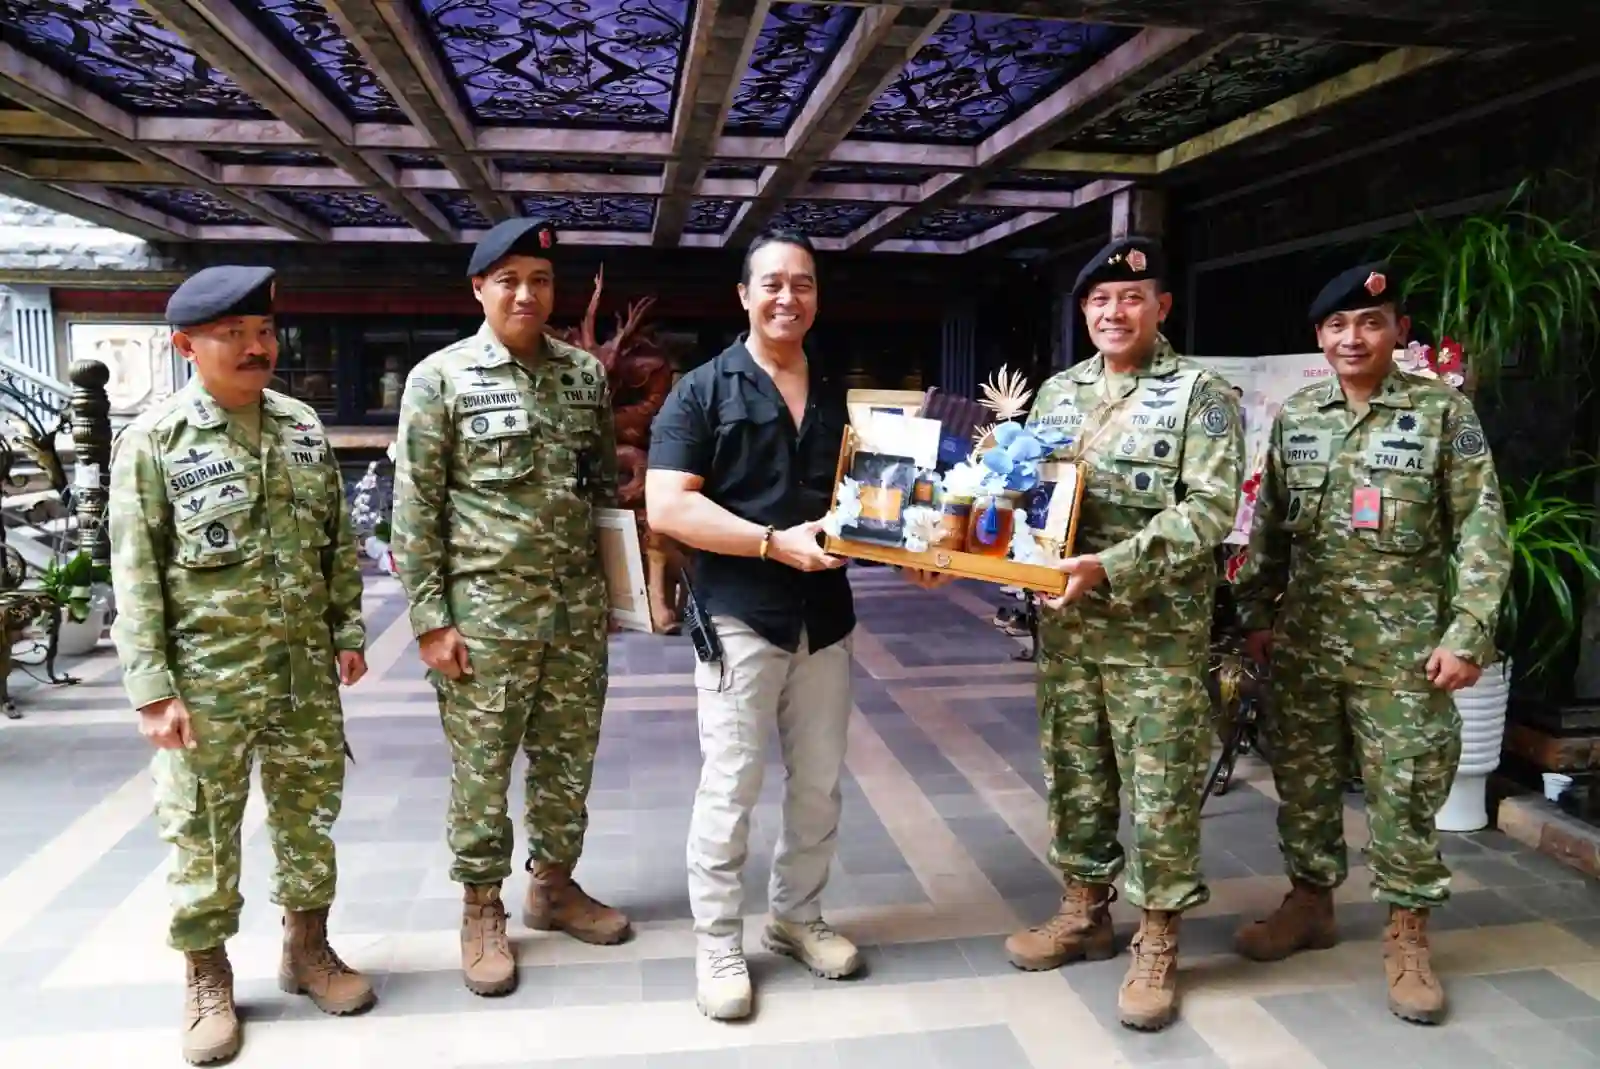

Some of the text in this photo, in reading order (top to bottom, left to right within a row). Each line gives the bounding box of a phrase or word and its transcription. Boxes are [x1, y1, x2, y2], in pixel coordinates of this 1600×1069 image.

[462, 392, 518, 408] SUMARYANTO
[563, 389, 584, 401] TNI
[1131, 414, 1177, 429] TNI AU
[291, 451, 313, 463] TNI
[1374, 453, 1425, 470] TNI AL
[170, 459, 236, 491] SUDIRMAN
